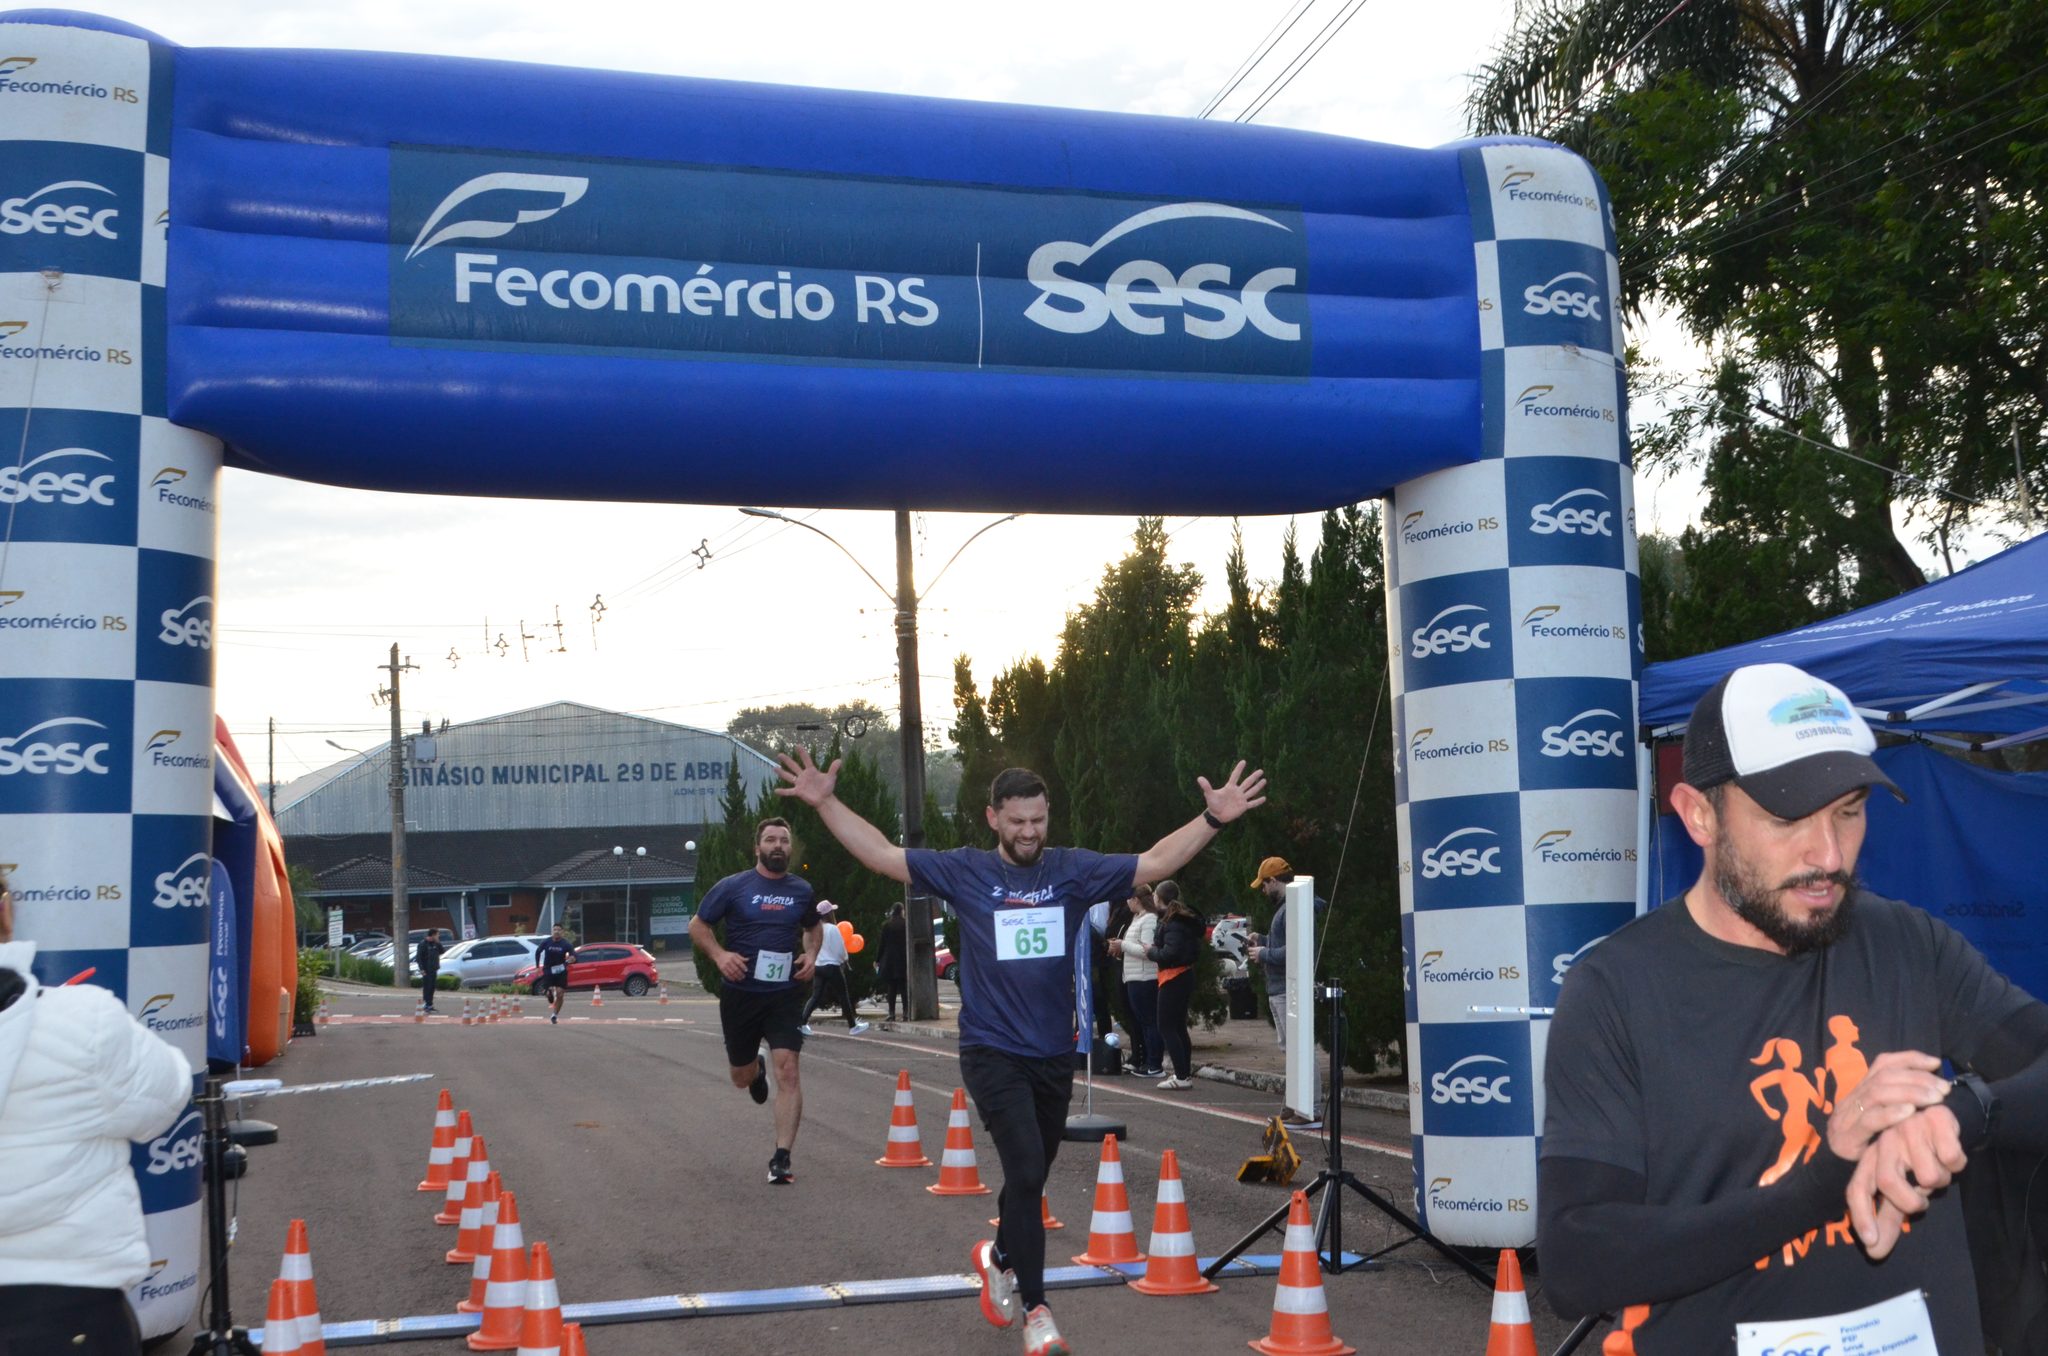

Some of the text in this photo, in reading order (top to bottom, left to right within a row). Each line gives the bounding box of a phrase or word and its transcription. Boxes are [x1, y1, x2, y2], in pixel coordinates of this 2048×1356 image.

[113, 87, 139, 104] RS
[1510, 188, 1598, 211] Fecomércio RS
[455, 252, 940, 327] Fecomércio RS
[107, 348, 132, 365] RS
[1524, 403, 1615, 422] Fecomércio RS
[1405, 517, 1499, 544] Fecomércio RS
[103, 615, 127, 631] RS
[1531, 623, 1610, 638] Fecomércio
[1612, 626, 1625, 640] RS
[1414, 738, 1509, 761] Fecomércio RS
[401, 761, 742, 787] GINÁSIO MUNICIPAL 29 DE ABRI
[1542, 848, 1637, 862] Fecomércio RS
[96, 885, 122, 900] RS
[1015, 927, 1048, 956] 65
[766, 963, 784, 979] 31
[1424, 967, 1494, 983] Fecomércio
[1498, 966, 1520, 981] RS
[1433, 1195, 1503, 1213] Fecomércio
[1508, 1198, 1529, 1213] RS
